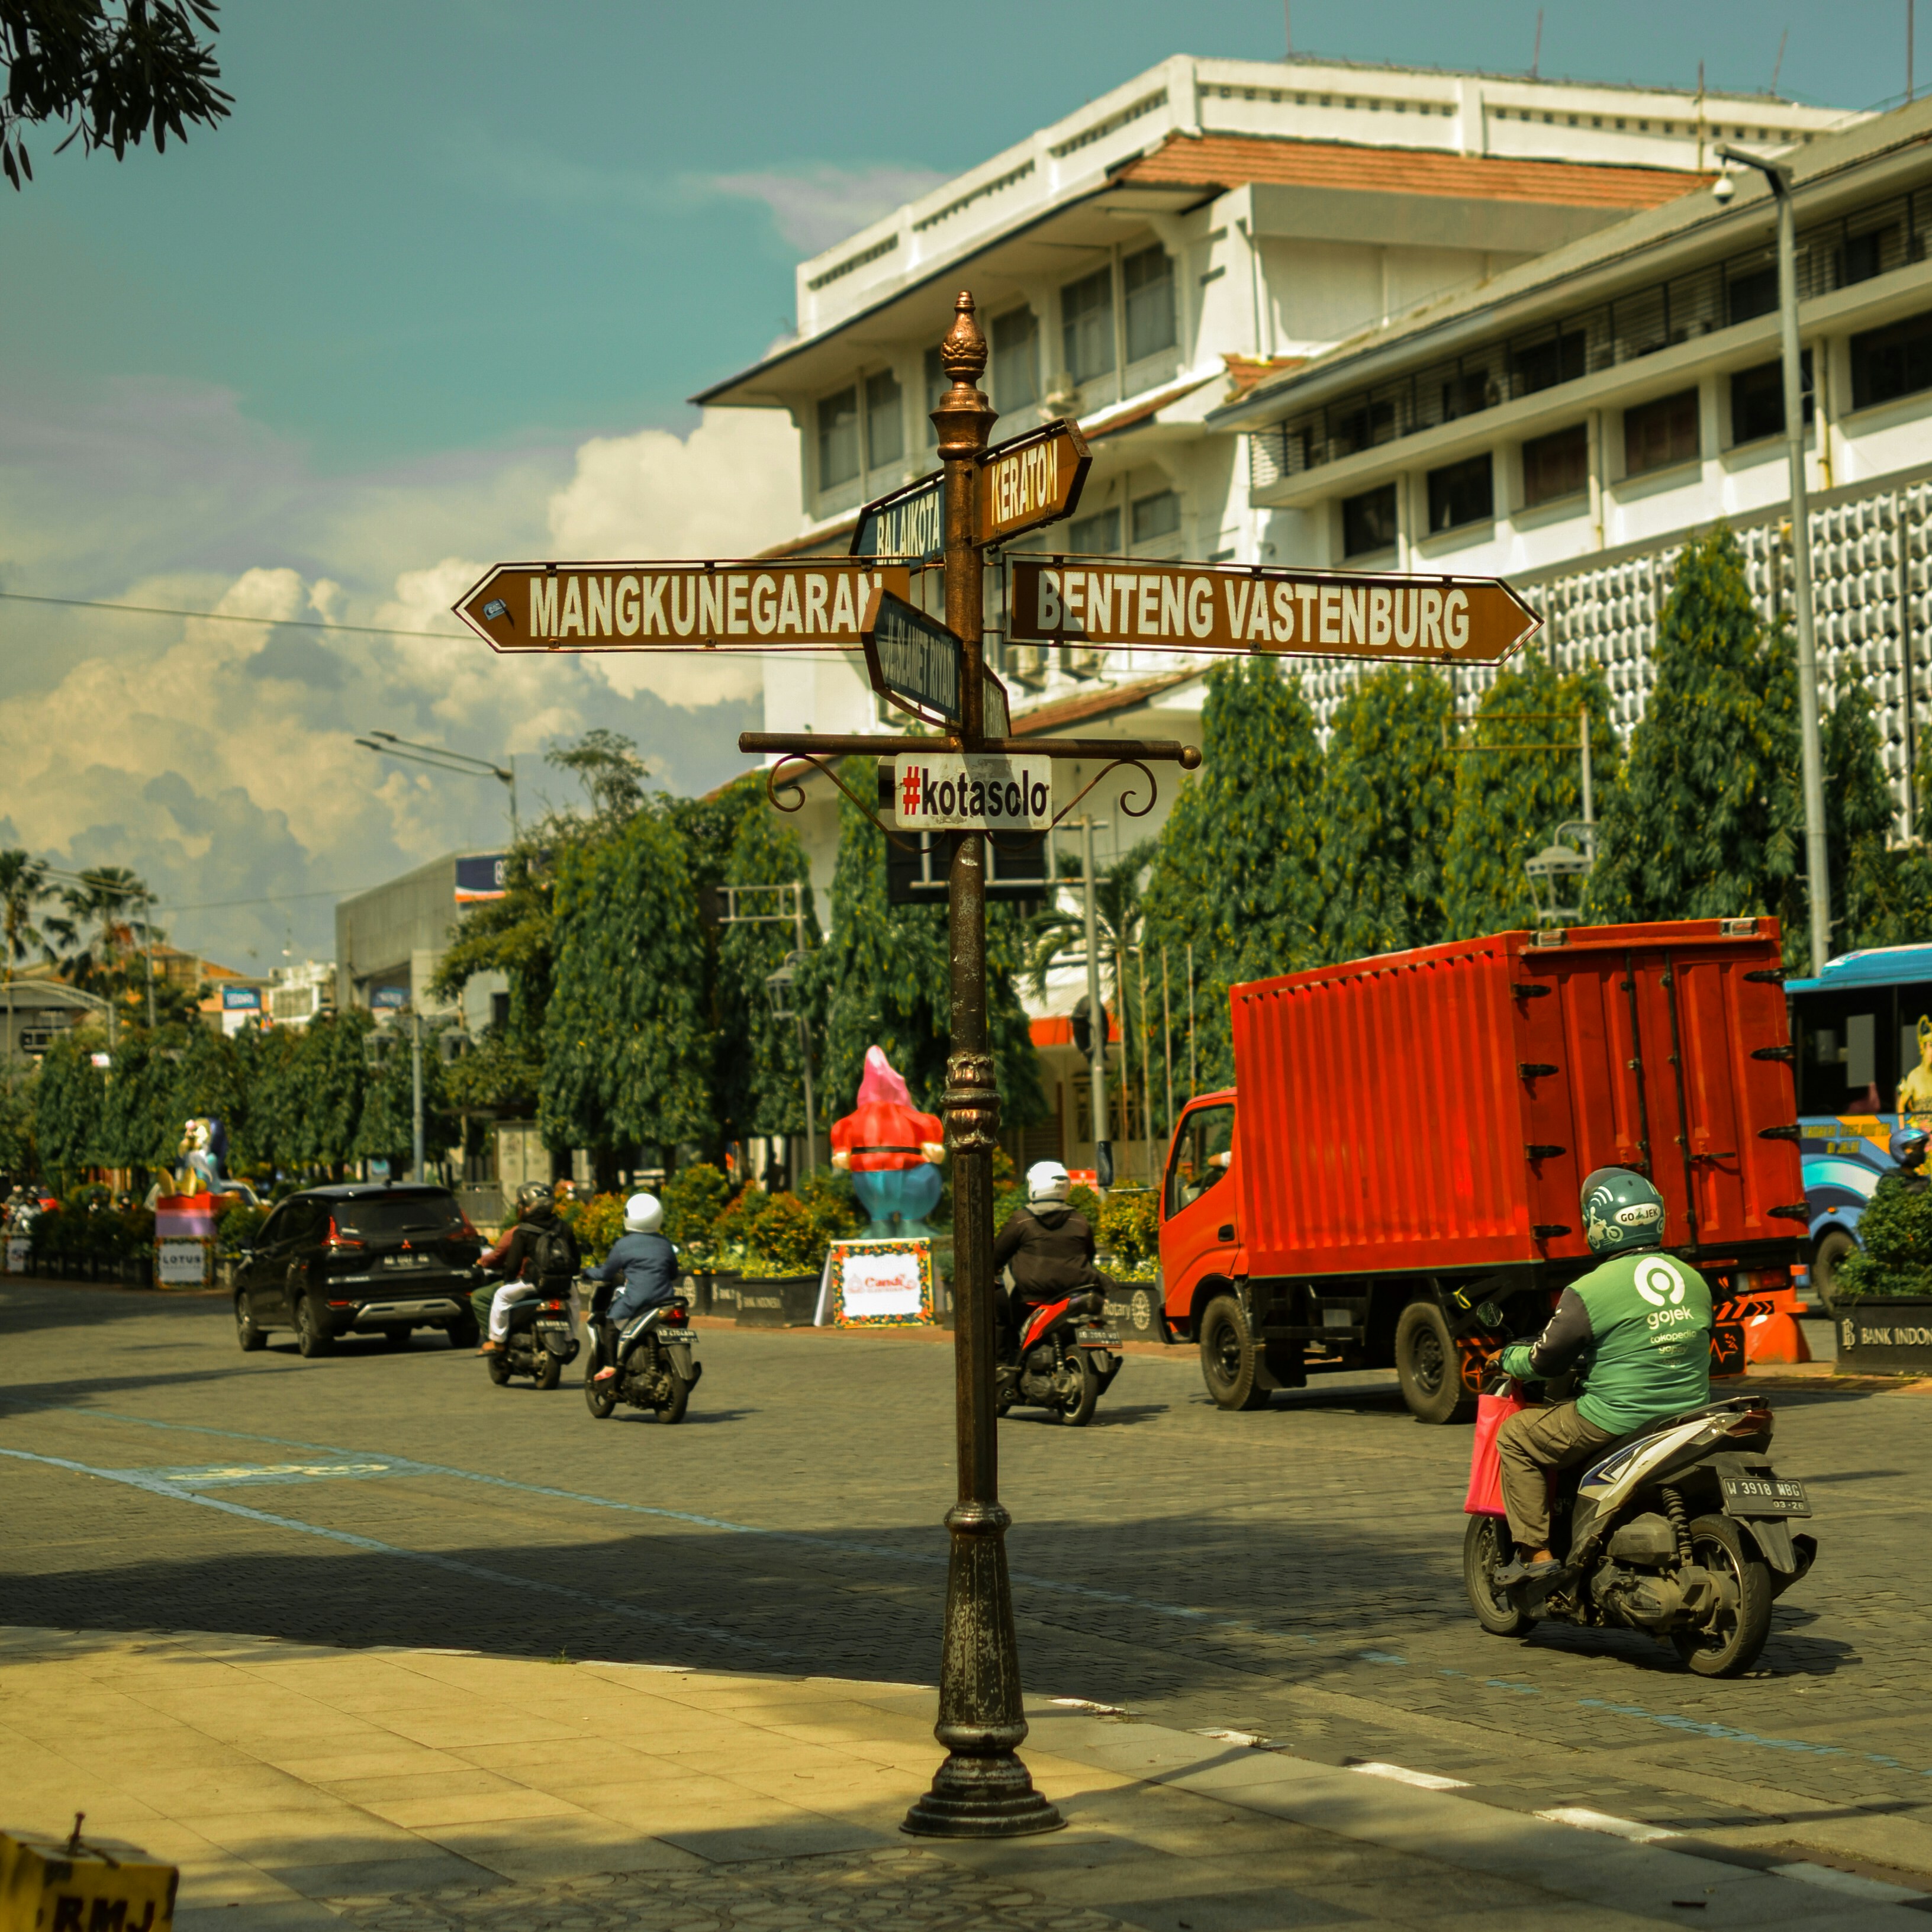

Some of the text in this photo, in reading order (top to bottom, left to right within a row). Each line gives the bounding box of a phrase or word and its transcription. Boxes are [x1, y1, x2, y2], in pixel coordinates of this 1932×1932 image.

[991, 439, 1058, 526] KERATON
[876, 491, 941, 565] BALAIKOTA
[1038, 569, 1469, 649] BENTENG VASTENBURG
[930, 636, 955, 710] RIYADI
[903, 766, 1047, 817] #kotasolo
[1621, 1208, 1658, 1222] GO JEK
[1104, 1299, 1131, 1320] Rotary
[1647, 1305, 1694, 1330] gojek
[1650, 1329, 1696, 1344] tokopedia
[1861, 1327, 1892, 1345] BANK
[1727, 1482, 1737, 1495] W
[1741, 1482, 1772, 1496] 3918
